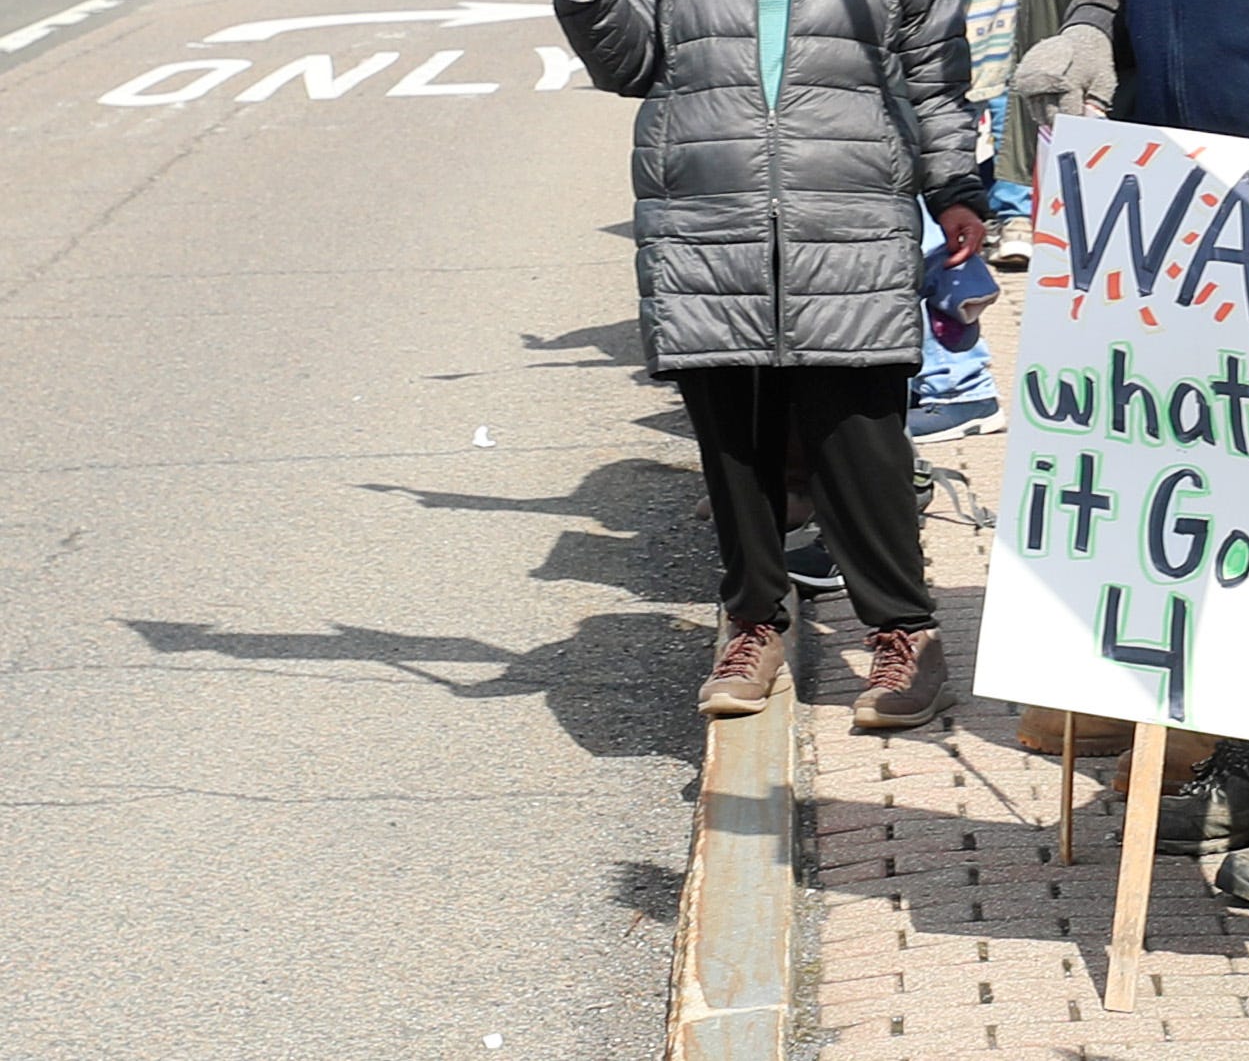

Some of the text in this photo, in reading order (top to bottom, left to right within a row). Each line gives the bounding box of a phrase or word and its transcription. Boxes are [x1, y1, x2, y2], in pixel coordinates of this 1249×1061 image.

[98, 46, 586, 107] ONLY
[1023, 452, 1114, 555] it
[1101, 585, 1188, 722] 4
